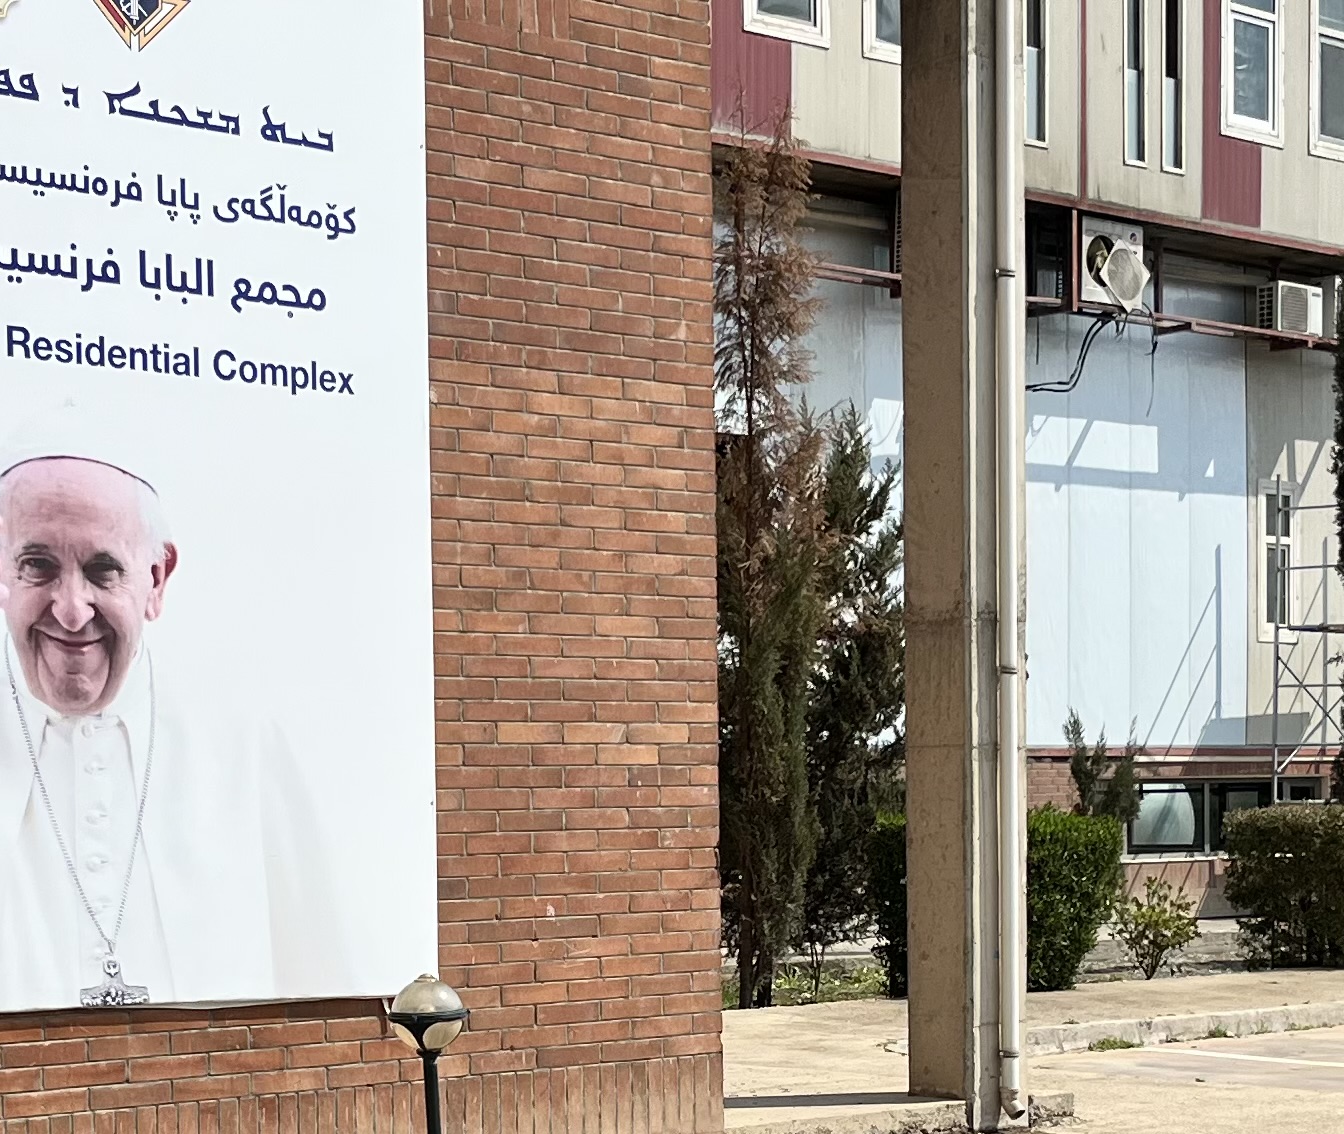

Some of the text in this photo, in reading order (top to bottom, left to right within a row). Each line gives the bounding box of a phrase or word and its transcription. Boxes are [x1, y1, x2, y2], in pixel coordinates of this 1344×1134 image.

[156, 173, 200, 225] پاپا
[138, 249, 215, 305] البابا
[230, 277, 327, 319] مجمع
[6, 324, 200, 378] Residential
[213, 349, 355, 396] Complex
